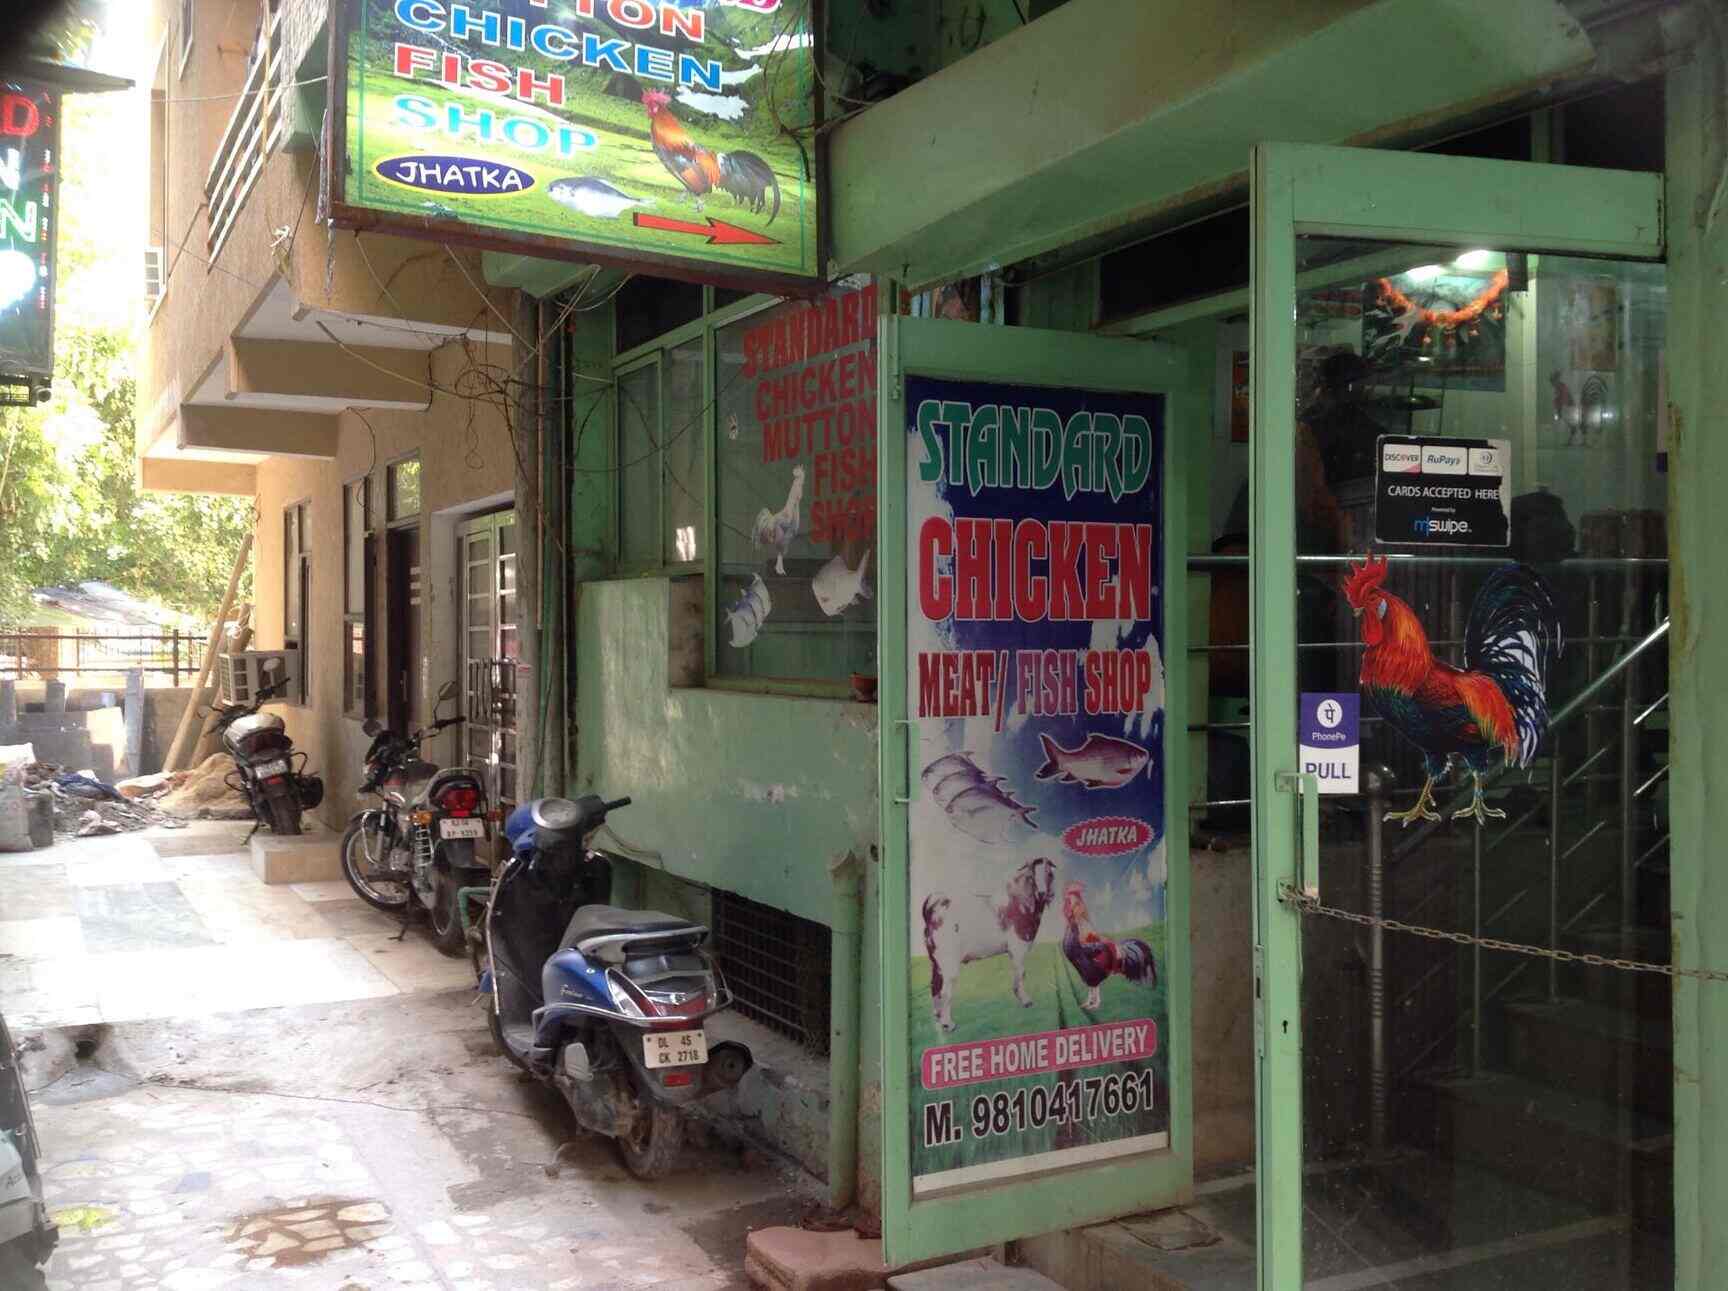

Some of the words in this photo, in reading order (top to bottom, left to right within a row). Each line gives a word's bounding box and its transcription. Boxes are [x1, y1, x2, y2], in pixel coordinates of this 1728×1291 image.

[394, 0, 722, 92] CHICKEN
[394, 44, 565, 106] FISH
[393, 94, 599, 158] SHOP
[396, 161, 524, 192] JHATKA
[743, 284, 877, 378] STANDARD
[755, 350, 877, 422] CHICKEN
[763, 398, 877, 464] MUTTON
[917, 399, 1152, 503] STANDARD
[1384, 453, 1419, 462] DISCOVER
[1387, 485, 1421, 497] CARDS
[1422, 487, 1471, 499] ACCEPTED
[1475, 489, 1500, 500] HERE
[918, 516, 1152, 623] CHICKEN
[1016, 649, 1078, 716] FISH
[1084, 649, 1151, 715] SHOP
[1312, 732, 1346, 741] PhonePe
[1305, 762, 1351, 779] PULL
[1076, 826, 1137, 847] JHATKA
[930, 1048, 983, 1084] FREE
[991, 1038, 1049, 1075] HOME
[1055, 1025, 1149, 1064] DELIVERY
[924, 1101, 961, 1147] M.
[971, 1069, 1153, 1137] 9810417661
